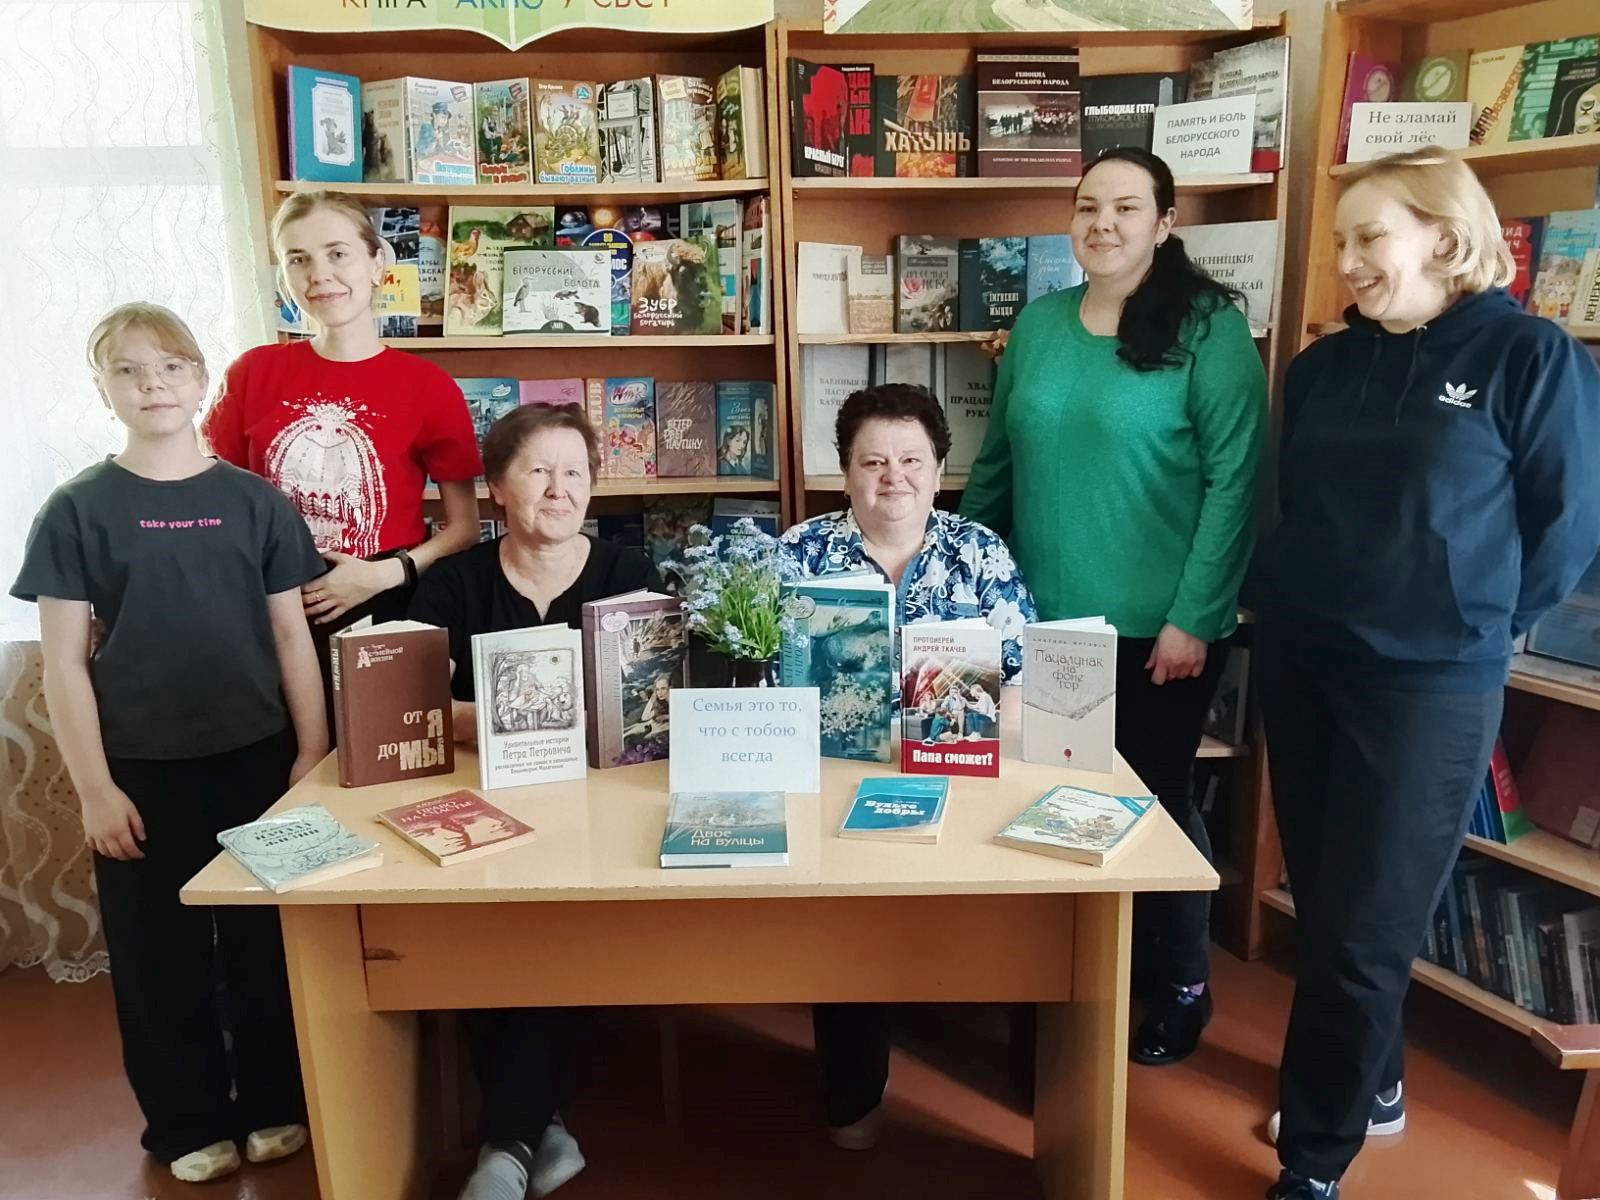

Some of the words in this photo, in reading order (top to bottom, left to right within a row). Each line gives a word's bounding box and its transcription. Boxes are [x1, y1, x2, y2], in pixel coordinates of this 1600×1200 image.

[1167, 116, 1207, 128] ПАМЯТЬ
[1209, 115, 1217, 124] И
[1219, 112, 1246, 123] БОЛЬ
[1369, 111, 1391, 124] Не
[1395, 110, 1456, 123] зламай
[885, 131, 971, 151] ХАТЫНЬ
[1166, 129, 1240, 144] БЕЛОРУССКОГО
[1365, 131, 1403, 144] свой
[1407, 130, 1436, 143] лёс
[1180, 147, 1220, 159] НАРОДА
[561, 164, 597, 174] Гоблины
[1191, 253, 1254, 265] МЕННІЦКІЯ
[512, 265, 574, 276] БЕЛОРУССКИЕ
[564, 279, 600, 288] БОЛОТА
[638, 297, 678, 314] ЗУБР
[1438, 395, 1472, 409] adidas
[667, 419, 693, 430] ВЕТЕР
[666, 439, 703, 450] ПАУТИНУ
[140, 520, 166, 528] take
[168, 520, 195, 530] your
[198, 518, 222, 527] time
[913, 636, 955, 644] ПРОТОИЕРЕЙ
[941, 645, 967, 653] ТКАЧЕВ
[1034, 649, 1104, 668] Пацалунак
[1052, 669, 1084, 682] фоне
[1063, 666, 1077, 674] на
[1059, 681, 1080, 692] гор
[693, 698, 742, 712] Семья
[748, 701, 775, 712] это
[779, 701, 802, 713] то,
[426, 708, 444, 738] Я
[699, 726, 726, 737] что
[731, 726, 740, 737] с
[744, 722, 796, 737] тобою
[399, 737, 446, 771] МЫ
[502, 749, 527, 762] Петра
[529, 746, 572, 759] Петровича
[721, 751, 773, 763] всегда
[912, 749, 942, 763] Папа
[944, 752, 993, 766] сможет?
[691, 829, 732, 838] Двое
[690, 838, 710, 846] на
[715, 837, 765, 847] вуліцы
